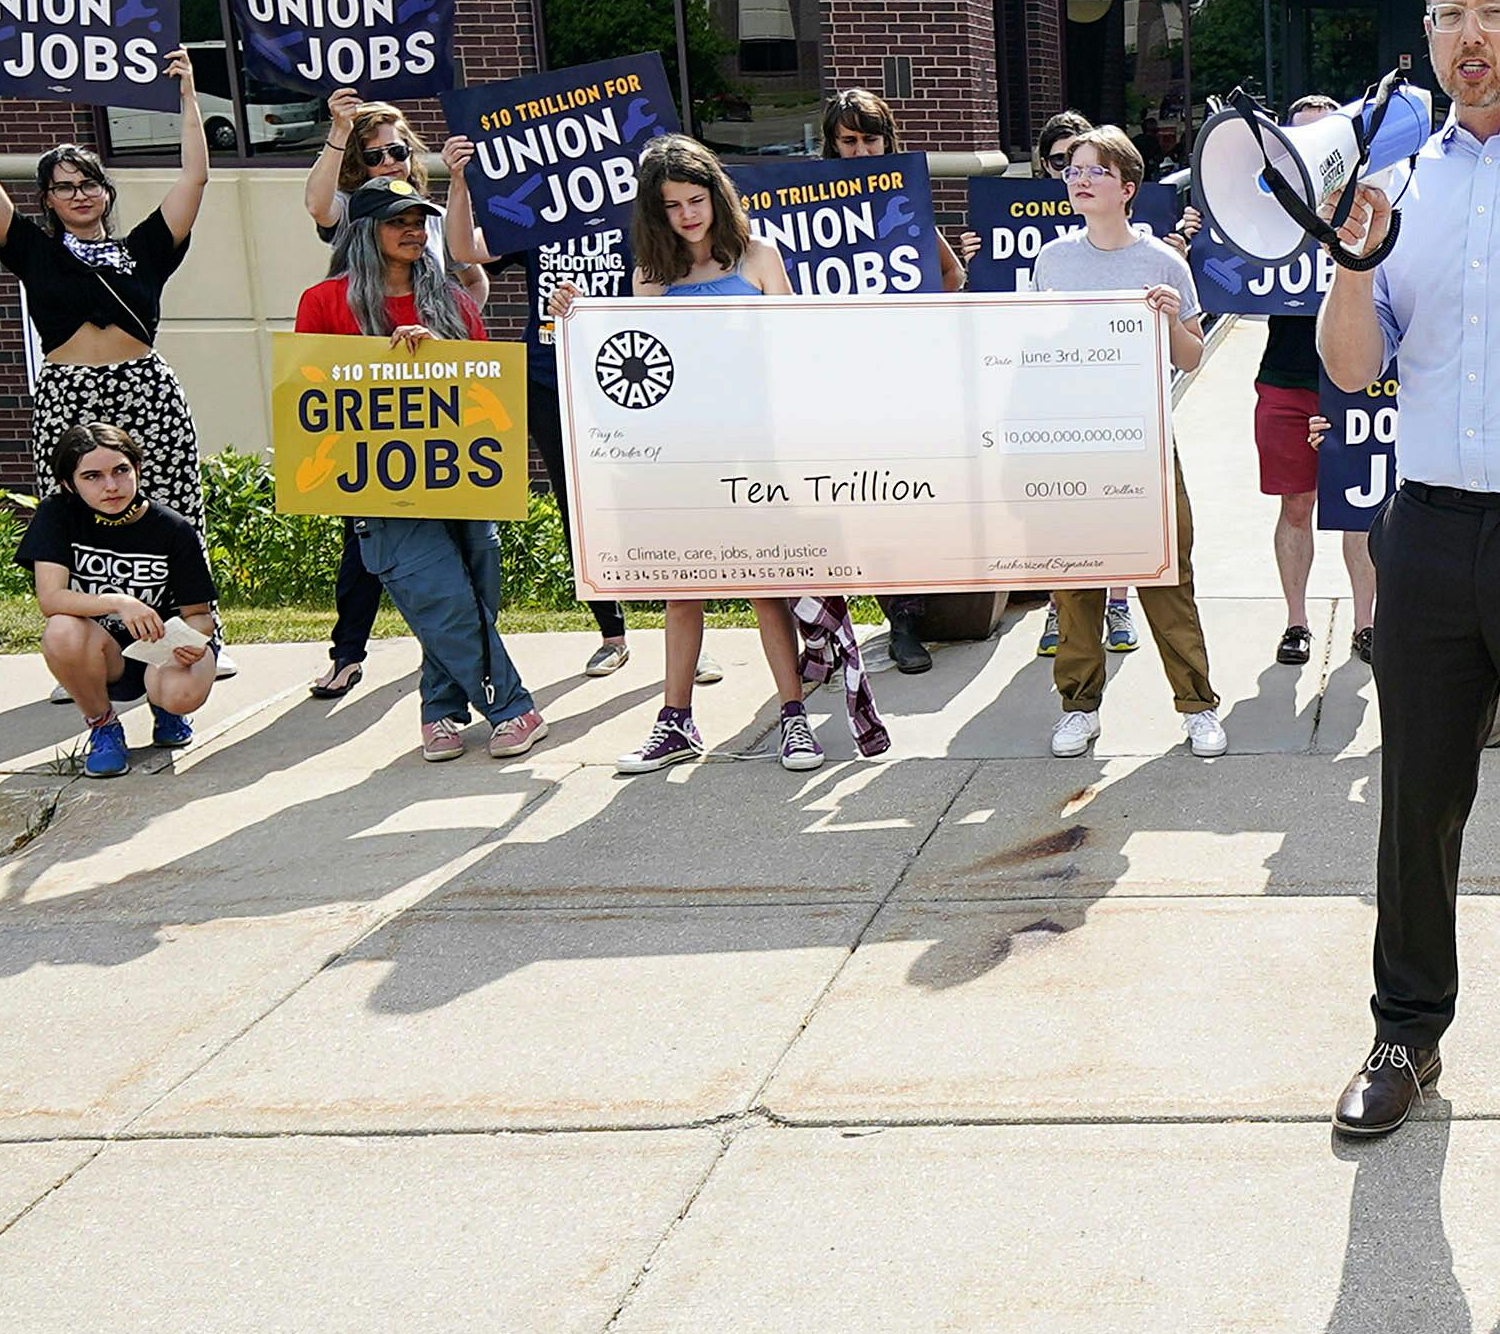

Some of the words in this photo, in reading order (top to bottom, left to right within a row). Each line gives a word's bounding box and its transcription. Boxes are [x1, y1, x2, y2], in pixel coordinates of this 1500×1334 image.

[4, 33, 157, 82] JOBS
[297, 32, 434, 83] JOBS
[481, 109, 511, 130] $10
[516, 86, 600, 120] TRILLION
[604, 75, 640, 97] FOR
[476, 107, 621, 180] UNION
[540, 157, 639, 222] JOB
[741, 192, 771, 211] $10
[778, 180, 861, 204] TRILLION
[868, 172, 903, 191] FOR
[992, 226, 1042, 260] DO
[539, 253, 625, 271] SHOOTING.
[1248, 248, 1334, 296] JOB
[538, 271, 625, 298] START
[1109, 319, 1142, 333] 1001
[332, 364, 363, 380] $10
[369, 362, 457, 380] TRILLION
[465, 361, 500, 378] FOR
[1022, 351, 1051, 365] June
[1056, 349, 1083, 363] 3rd,
[1088, 348, 1120, 362] 2021
[299, 386, 459, 432] GREEN
[1005, 429, 1142, 444] 10,000,000,000,000
[337, 438, 502, 492] JOBS
[720, 476, 790, 504] Ten
[803, 470, 937, 502] Trillion
[1025, 481, 1087, 497] 00/100
[75, 550, 169, 580] VOICES
[627, 548, 680, 561] Climate,
[684, 550, 716, 560] care,
[720, 546, 752, 562] jobs,
[756, 545, 779, 558] and
[784, 544, 827, 560] justice
[828, 566, 862, 577] 1001
